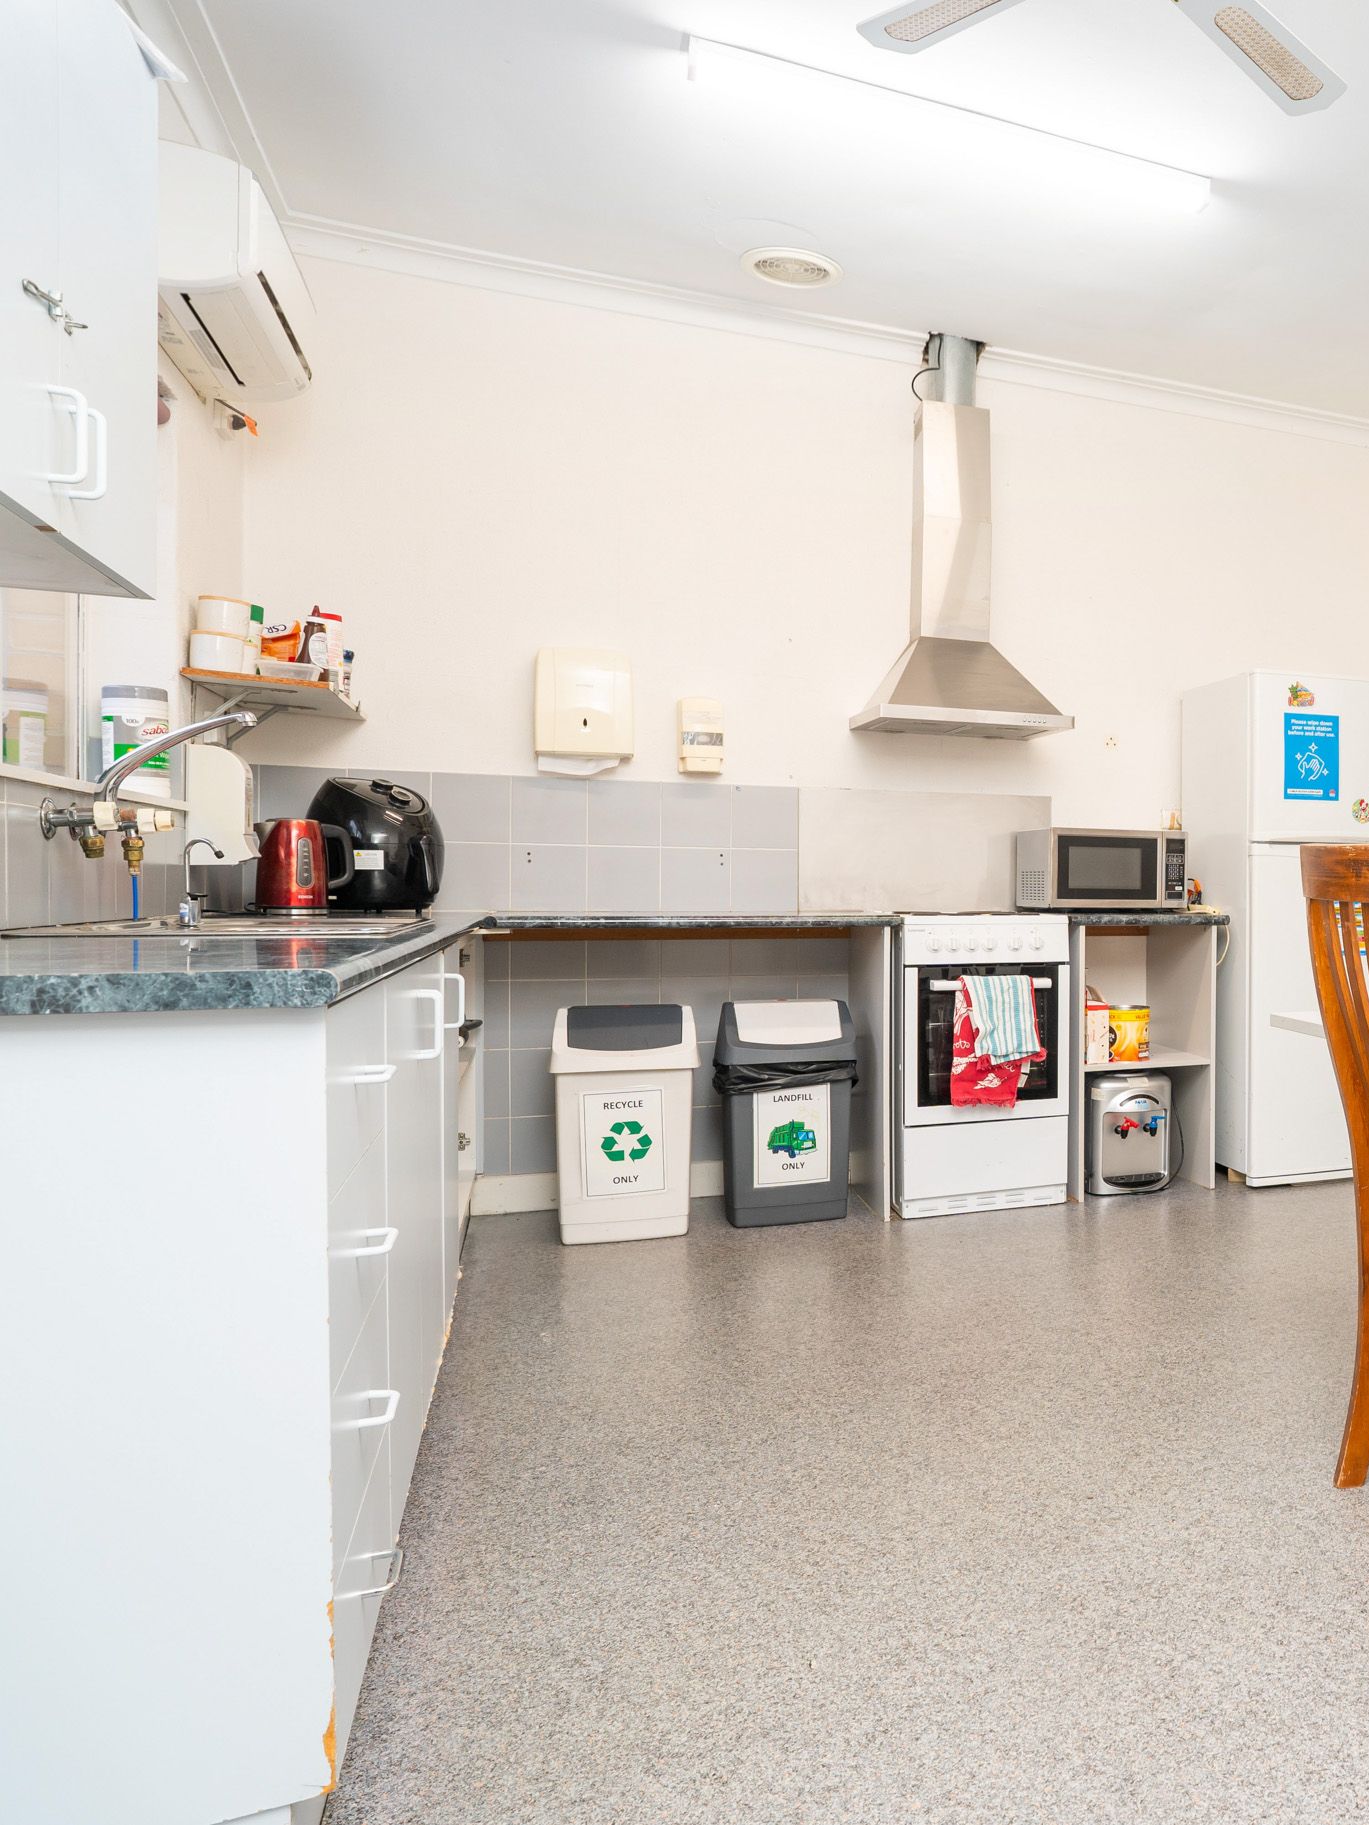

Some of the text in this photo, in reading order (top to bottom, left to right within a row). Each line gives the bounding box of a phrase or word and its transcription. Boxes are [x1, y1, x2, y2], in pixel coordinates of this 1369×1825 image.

[265, 624, 287, 634] CSR
[141, 725, 169, 736] sabc
[773, 1093, 813, 1102] LANDFILL
[603, 1100, 643, 1110] RECYCLE
[782, 1162, 805, 1170] ONLY
[612, 1175, 639, 1184] ONLY
